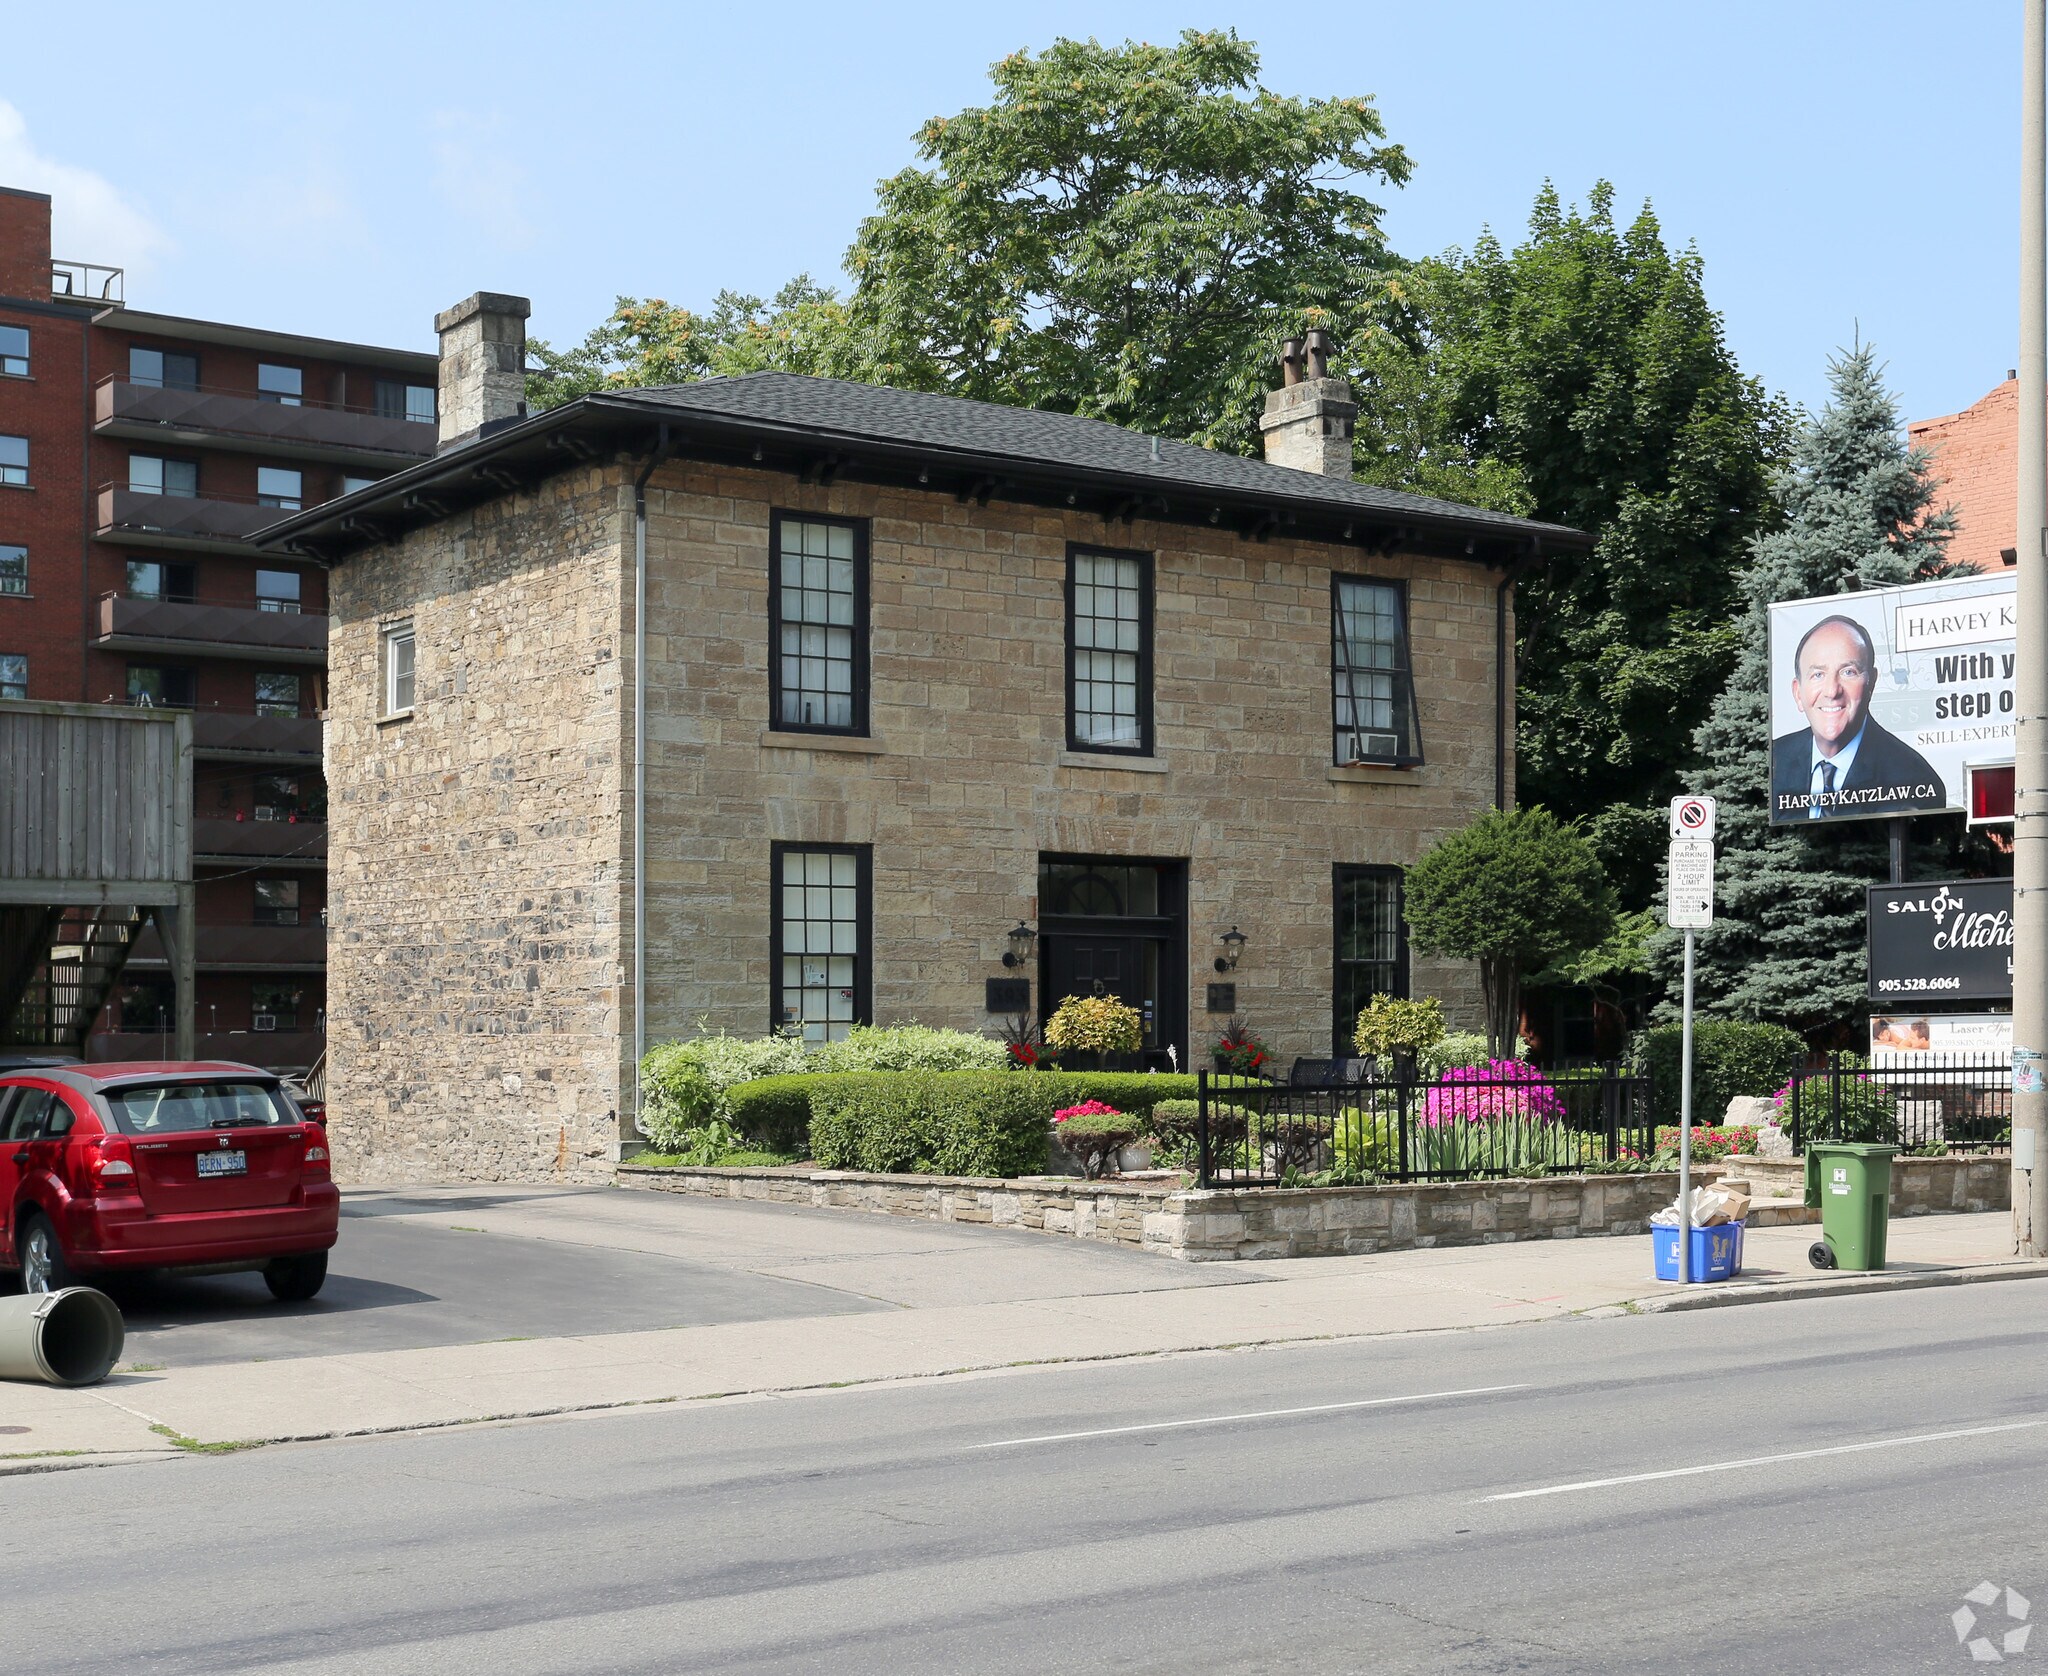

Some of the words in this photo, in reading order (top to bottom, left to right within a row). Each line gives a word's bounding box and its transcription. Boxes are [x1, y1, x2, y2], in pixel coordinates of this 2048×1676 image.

[1909, 611, 1991, 637] HARVEY
[1935, 652, 1993, 683] With
[1936, 691, 1991, 719] step
[1999, 689, 2015, 713] o
[1878, 977, 1960, 992] 905.528.6064
[1950, 1022, 1984, 1034] Laser
[227, 1156, 244, 1169] 950
